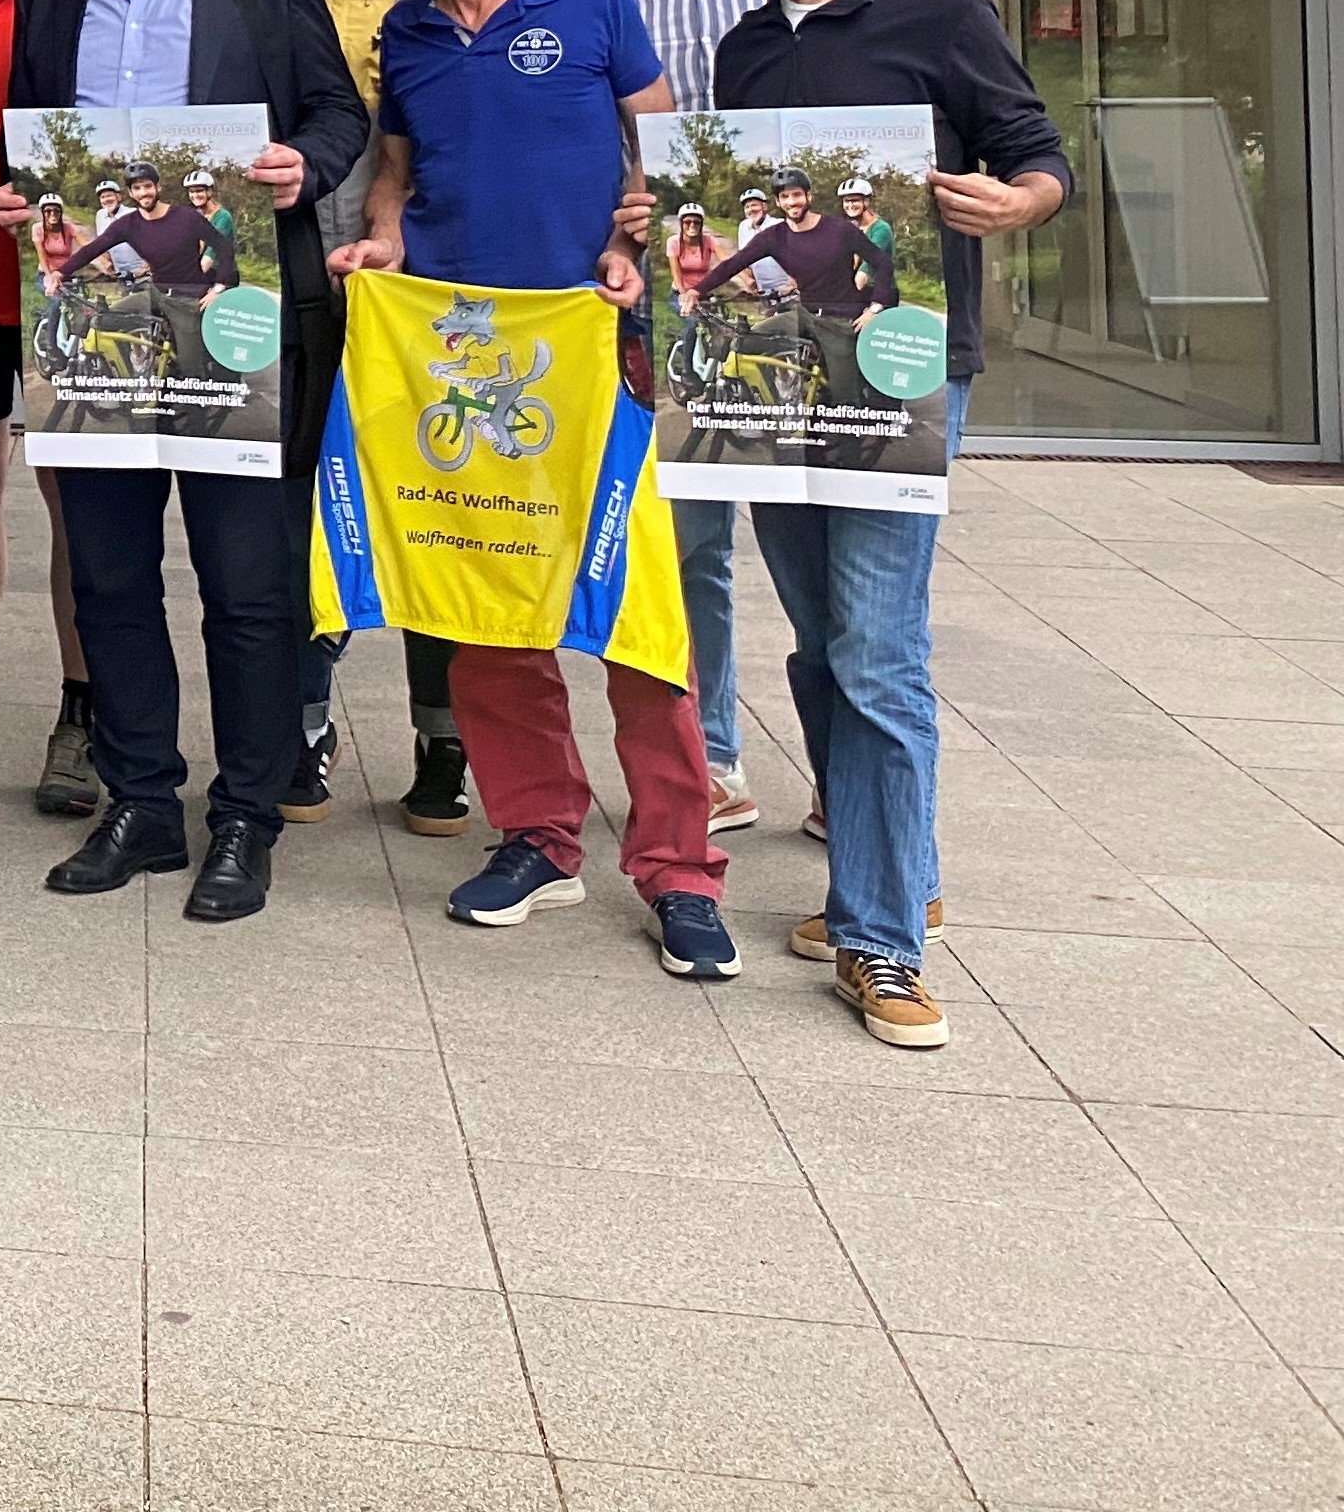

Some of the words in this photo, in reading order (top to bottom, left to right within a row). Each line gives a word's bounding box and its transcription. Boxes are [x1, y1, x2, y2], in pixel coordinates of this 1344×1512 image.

[164, 121, 259, 137] STADTRADELN
[819, 125, 925, 140] STADTRADELN
[52, 375, 73, 387] Der
[75, 375, 148, 388] Wettbewerb
[167, 377, 251, 395] Radförderung,
[56, 389, 132, 402] Klimaschutz
[134, 390, 157, 402] und
[158, 391, 246, 407] Lebensqualität.
[686, 400, 711, 414] Der
[713, 401, 795, 416] Wettbewerb
[816, 404, 913, 424] Radförderung,
[692, 416, 777, 431] Klimaschutz
[779, 418, 805, 431] und
[807, 421, 908, 437] Lebensqualität.
[331, 456, 364, 556] MAISCH
[397, 485, 457, 505] Rad-AG
[463, 493, 559, 517] Wolfhagen
[588, 479, 626, 581] MAISCH
[406, 529, 484, 552] Wolfhagen
[487, 539, 553, 559] radelt...
